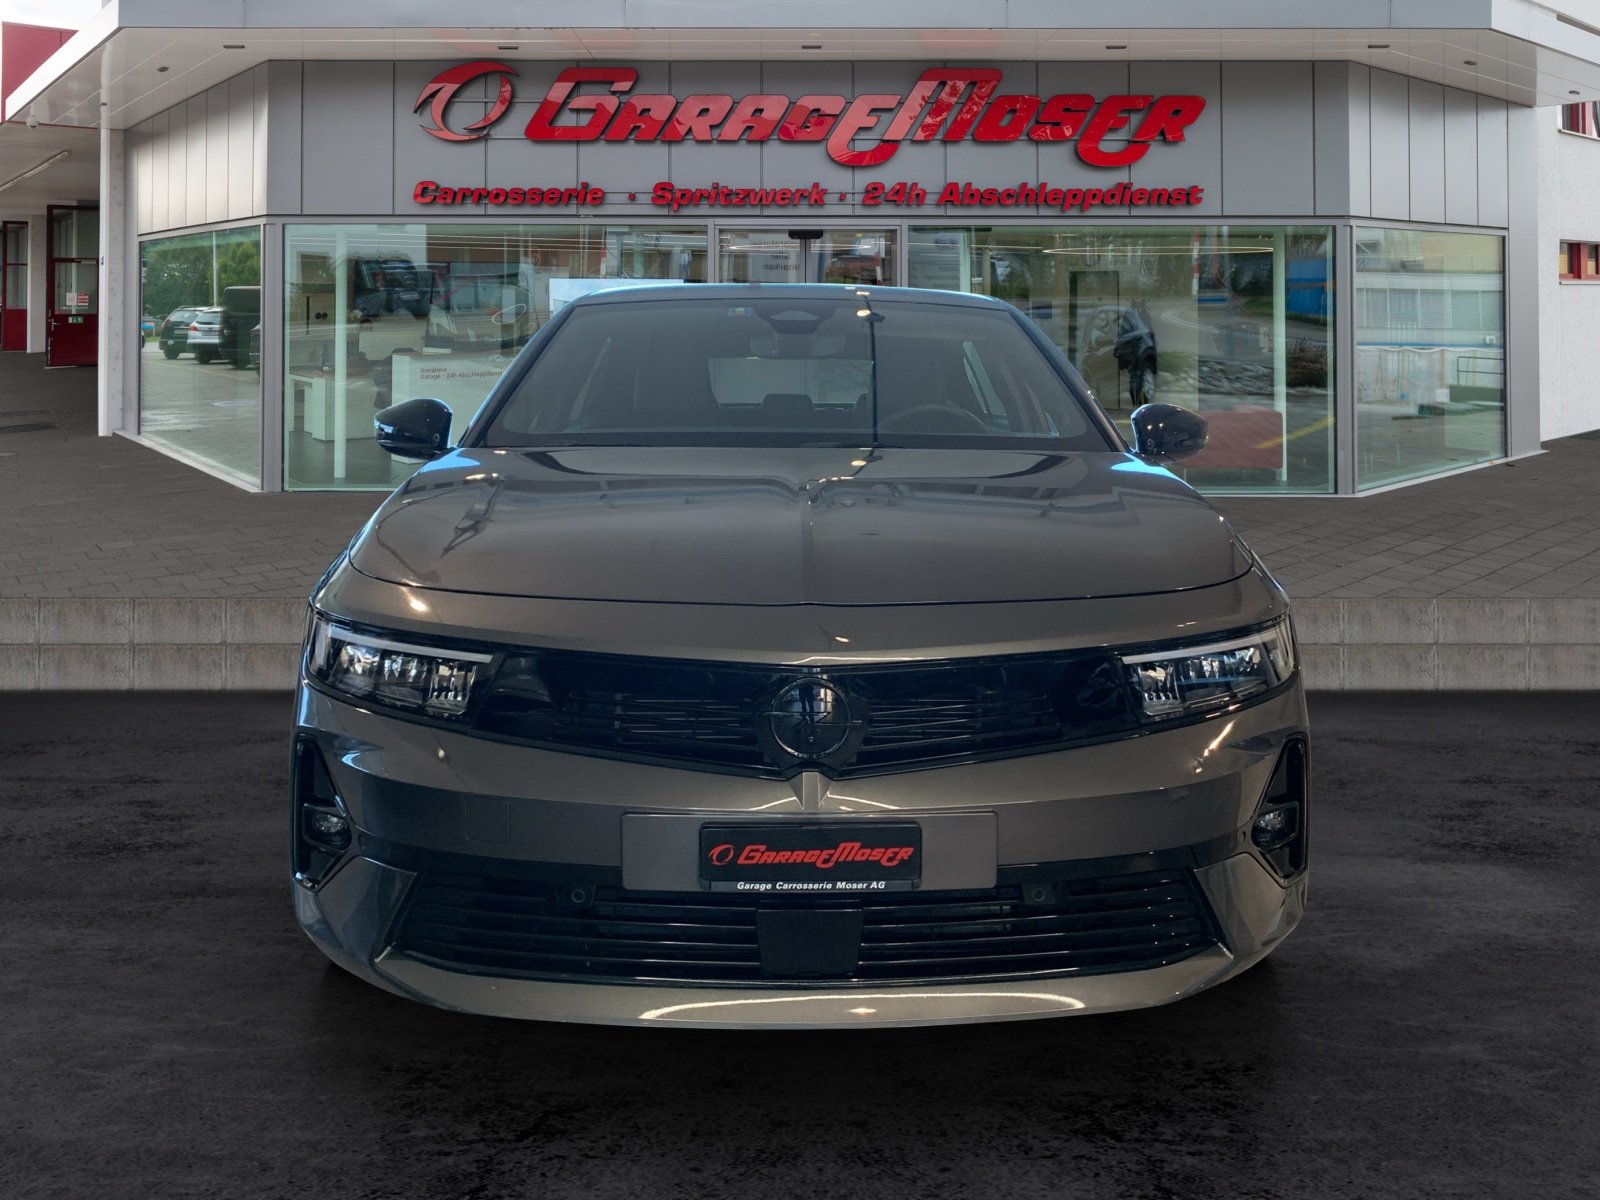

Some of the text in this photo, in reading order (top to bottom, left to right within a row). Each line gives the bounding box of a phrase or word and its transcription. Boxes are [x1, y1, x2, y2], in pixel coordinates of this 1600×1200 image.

[413, 181, 1203, 212] Carrosserie Spritzwerk 24h Abschleppdienst
[736, 880, 886, 891] Garage Carrosserie Moser AG
